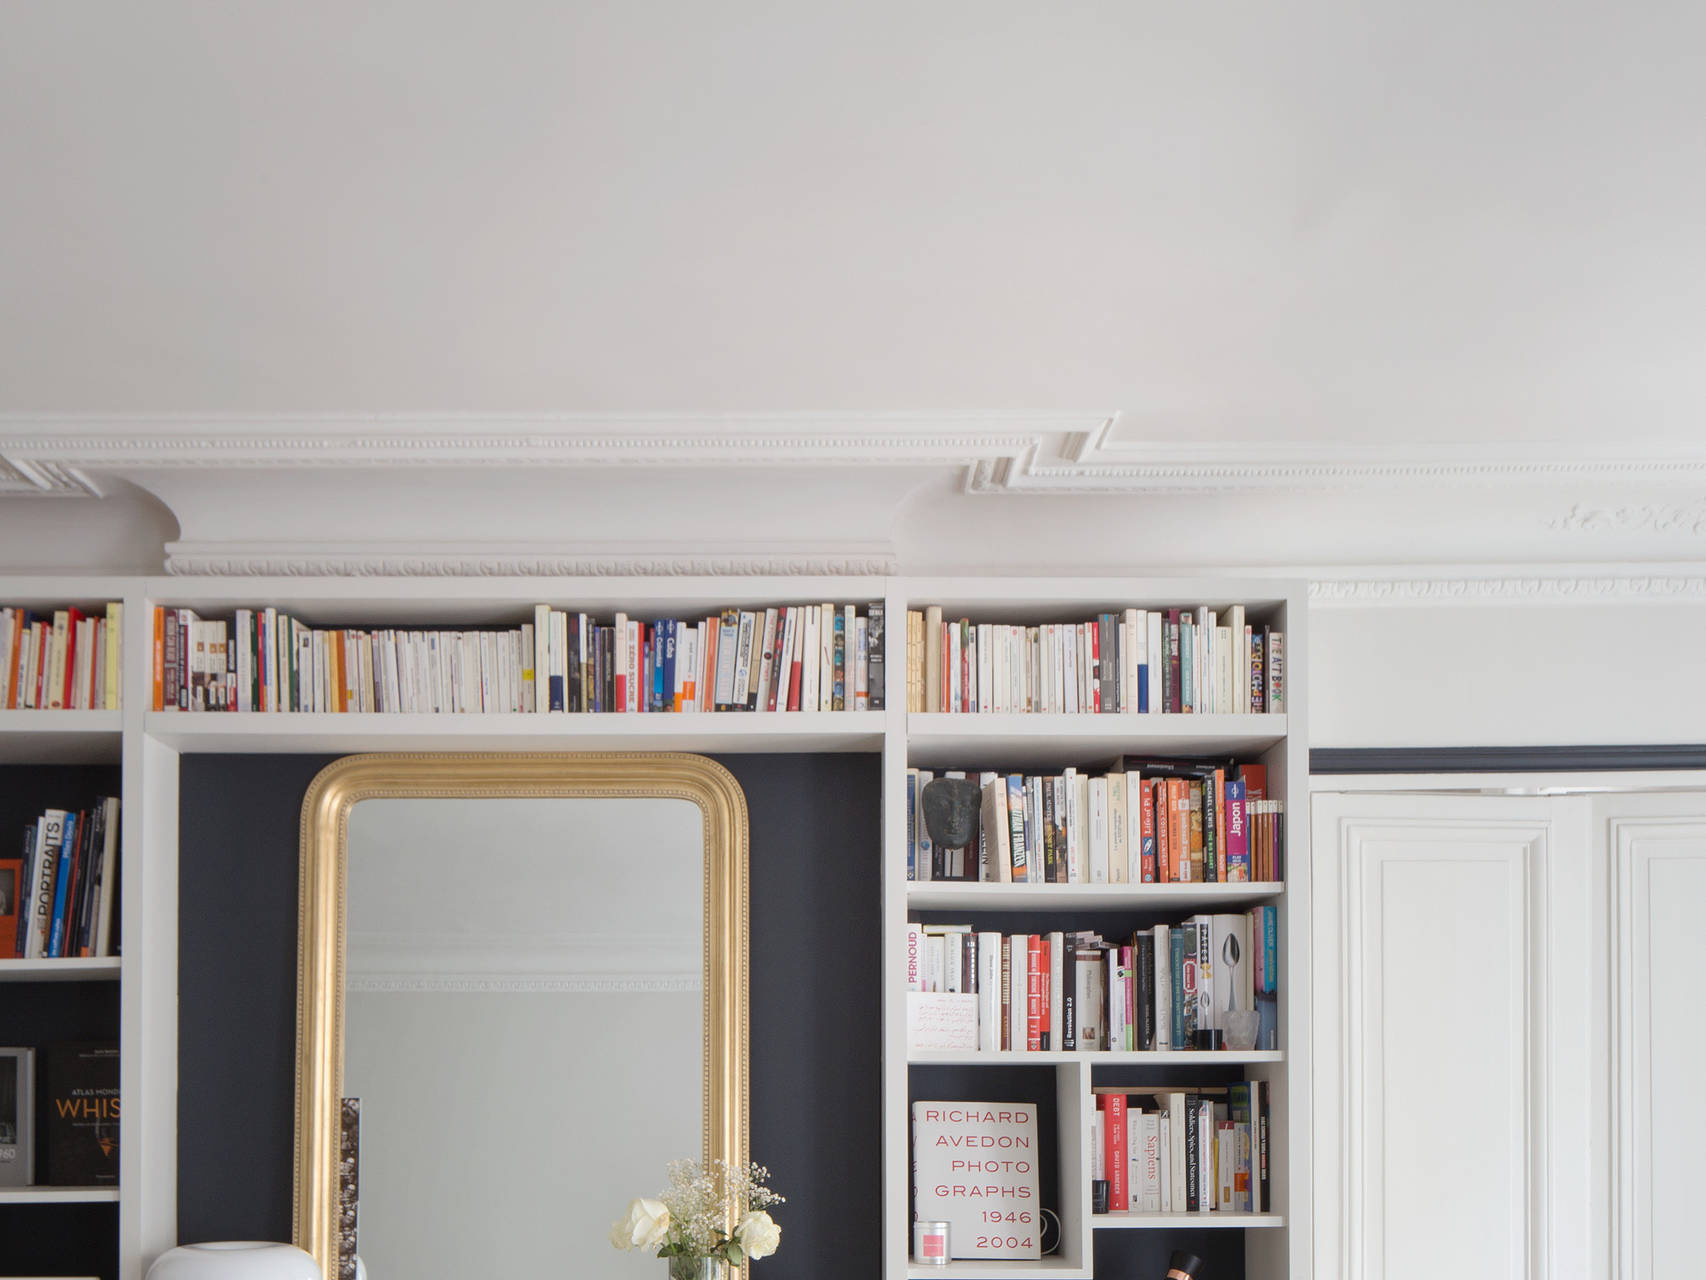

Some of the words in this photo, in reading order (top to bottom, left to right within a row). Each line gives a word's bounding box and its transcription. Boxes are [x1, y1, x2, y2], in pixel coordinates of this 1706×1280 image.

[1230, 802, 1243, 836] Japon
[38, 822, 60, 916] PORTRAITS
[908, 931, 918, 984] PERNOUD
[72, 1088, 94, 1096] ATLAS
[56, 1098, 120, 1118] WHIS
[1112, 1097, 1120, 1116] DEBT
[926, 1110, 1030, 1124] RICHARD
[935, 1135, 1030, 1148] AVEDON
[1144, 1135, 1159, 1181] Sapiens
[951, 1160, 1030, 1174] PHOTO
[934, 1184, 1032, 1198] GRAPHS
[982, 1210, 1032, 1224] 1946
[976, 1236, 1033, 1249] 2004
